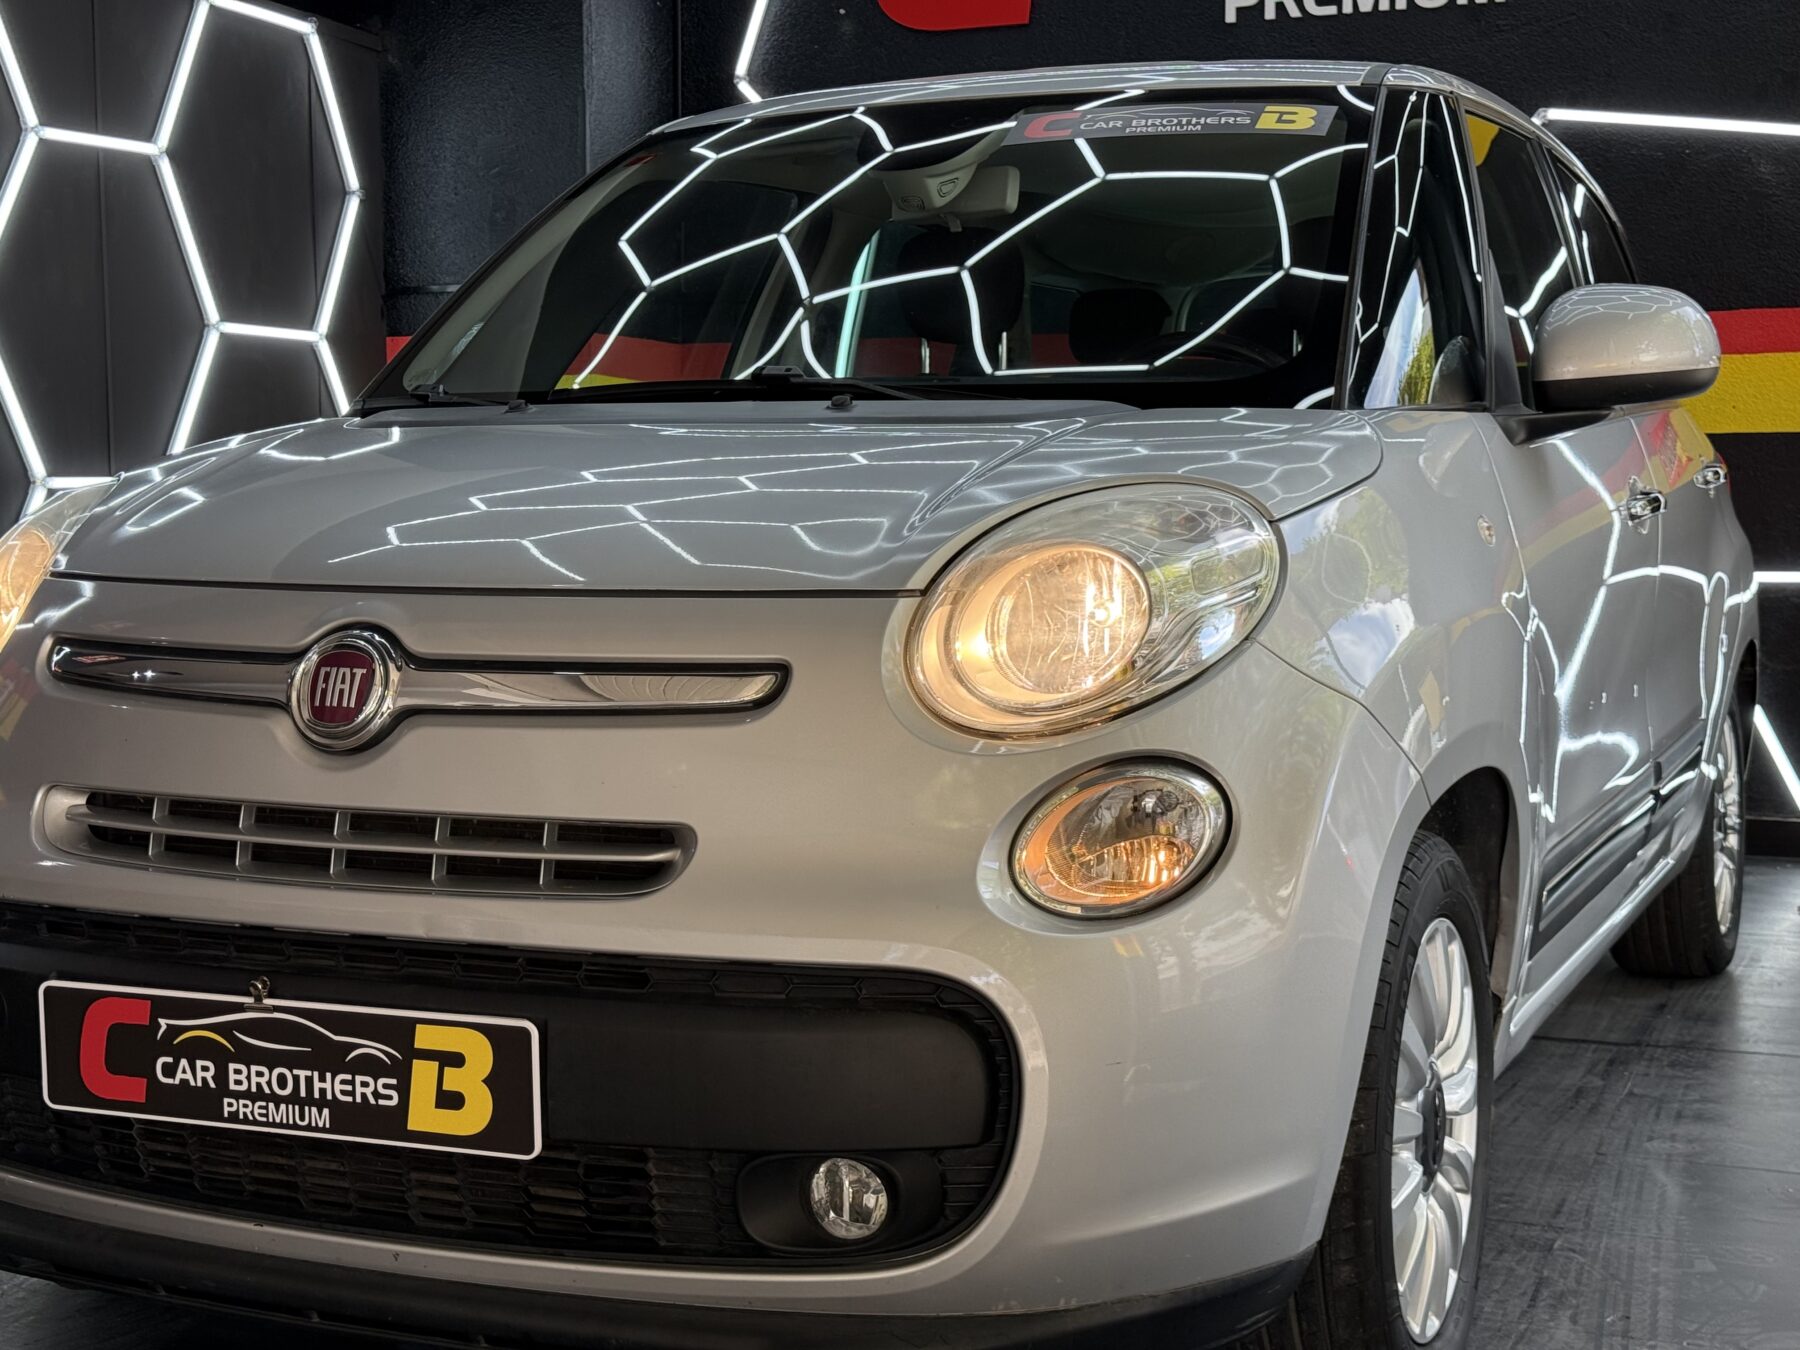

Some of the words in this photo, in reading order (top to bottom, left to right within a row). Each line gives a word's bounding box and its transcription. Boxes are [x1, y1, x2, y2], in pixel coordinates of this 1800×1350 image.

[1079, 120, 1123, 130] CAR
[1131, 116, 1252, 127] BROTHERS
[1125, 124, 1202, 134] PREMIUM
[314, 666, 367, 708] FIAT
[79, 996, 152, 1104] C
[155, 1056, 217, 1088] CAR
[228, 1062, 400, 1107] BROTHERS
[406, 1023, 494, 1137] B
[222, 1097, 331, 1129] PREMIUM
